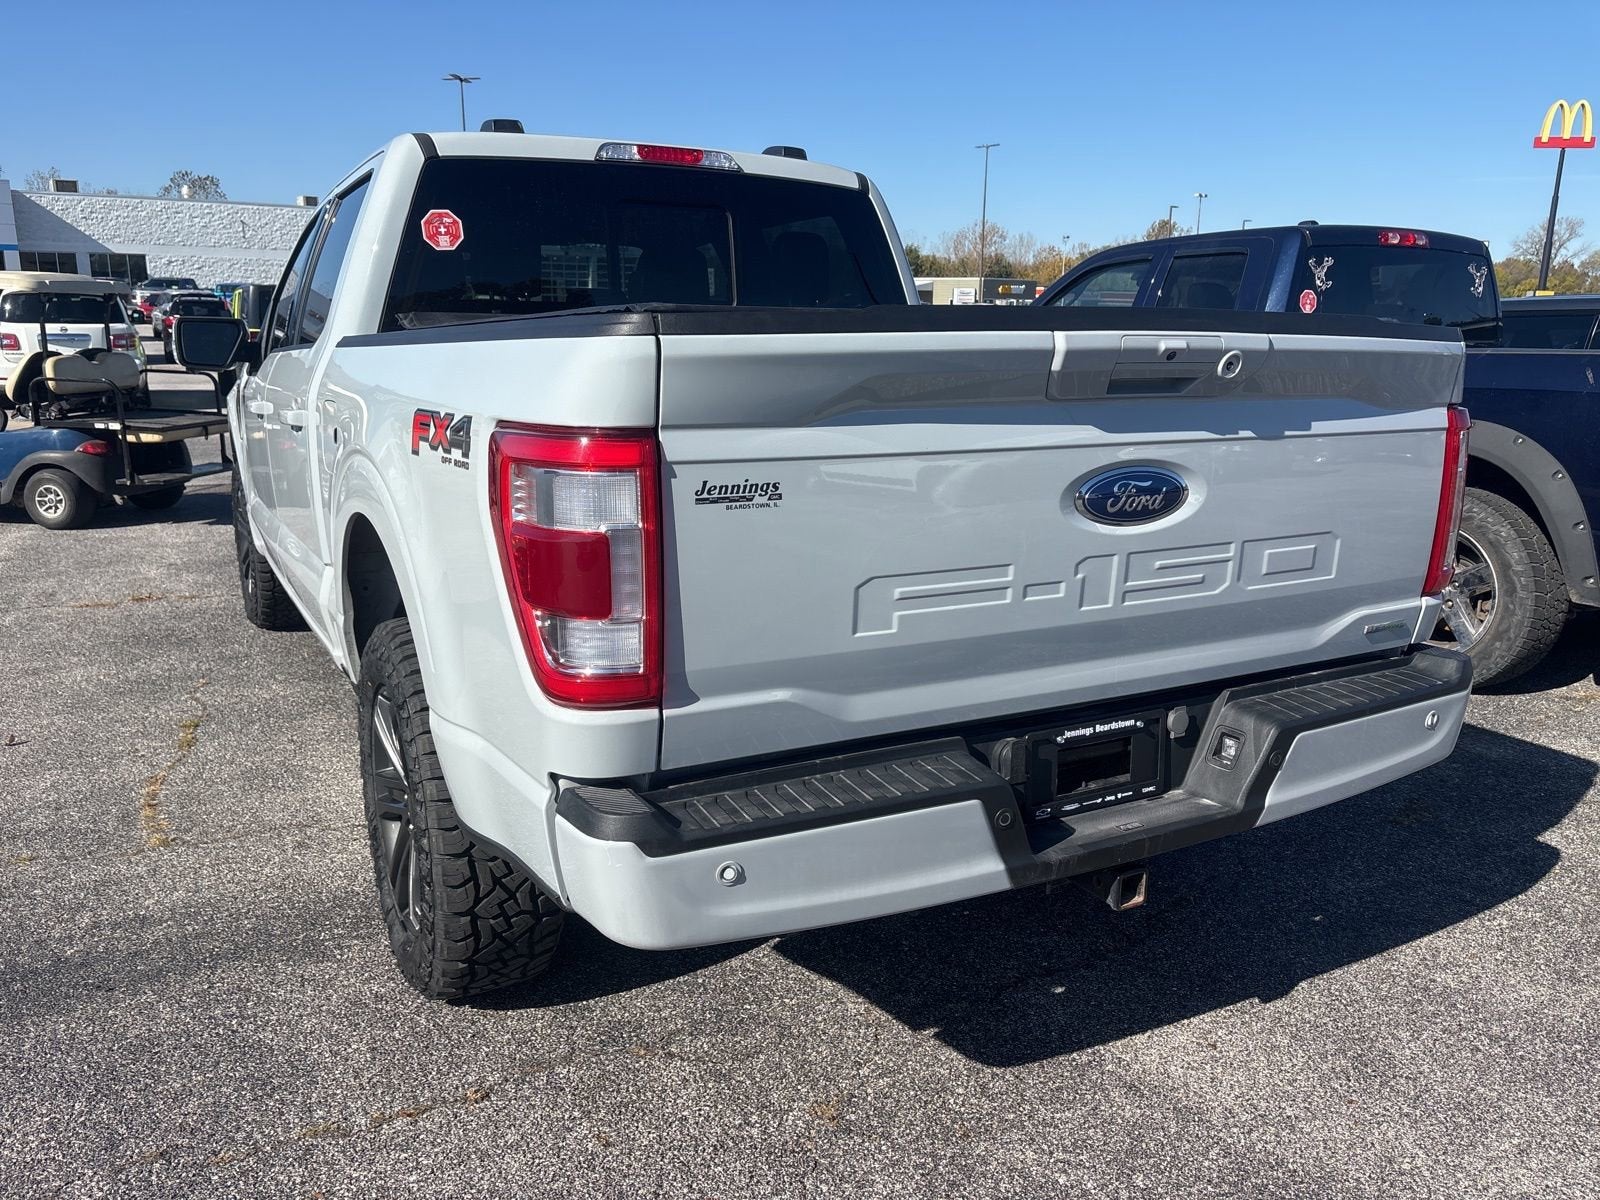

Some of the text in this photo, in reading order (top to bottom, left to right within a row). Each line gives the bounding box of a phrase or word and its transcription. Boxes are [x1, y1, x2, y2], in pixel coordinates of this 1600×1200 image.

[411, 408, 473, 459] FX4
[441, 456, 469, 470] OFF ROAD
[695, 479, 781, 497] Jennings
[1107, 480, 1167, 513] Ford
[853, 531, 1340, 637] F-150
[1063, 719, 1135, 739] Jennings Beardstown
